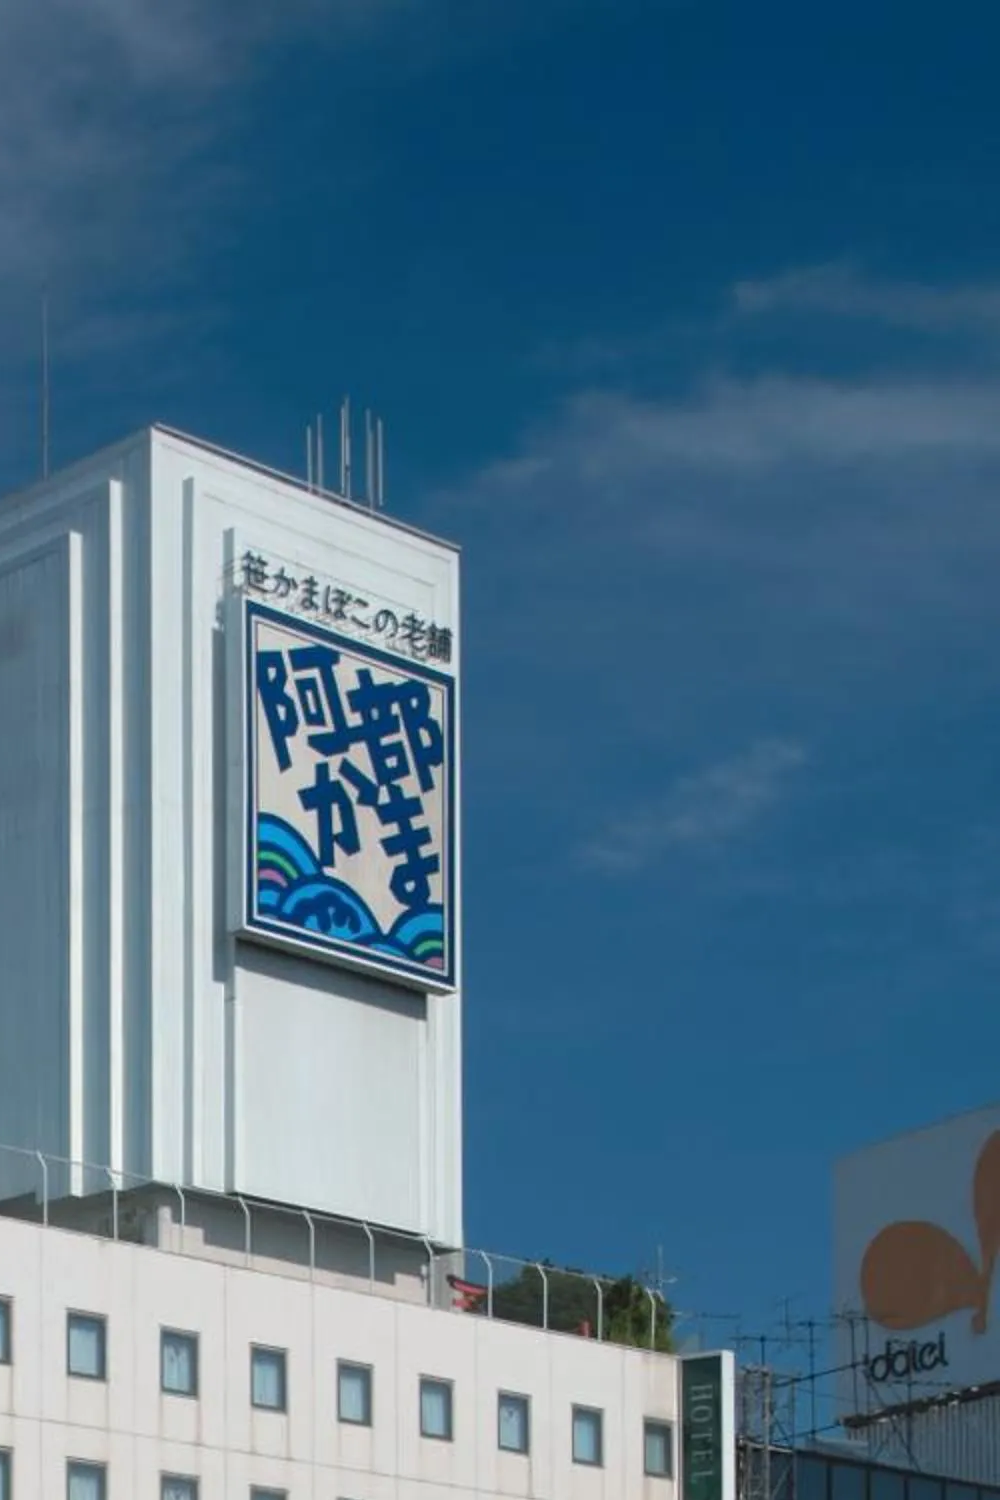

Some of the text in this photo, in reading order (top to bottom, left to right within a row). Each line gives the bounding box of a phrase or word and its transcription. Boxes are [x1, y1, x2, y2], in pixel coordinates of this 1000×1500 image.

[242, 551, 453, 664] 笹かまぼこの老舗
[257, 644, 444, 793] 阿部
[297, 757, 441, 909] かま
[690, 1384, 714, 1485] HOTEL
